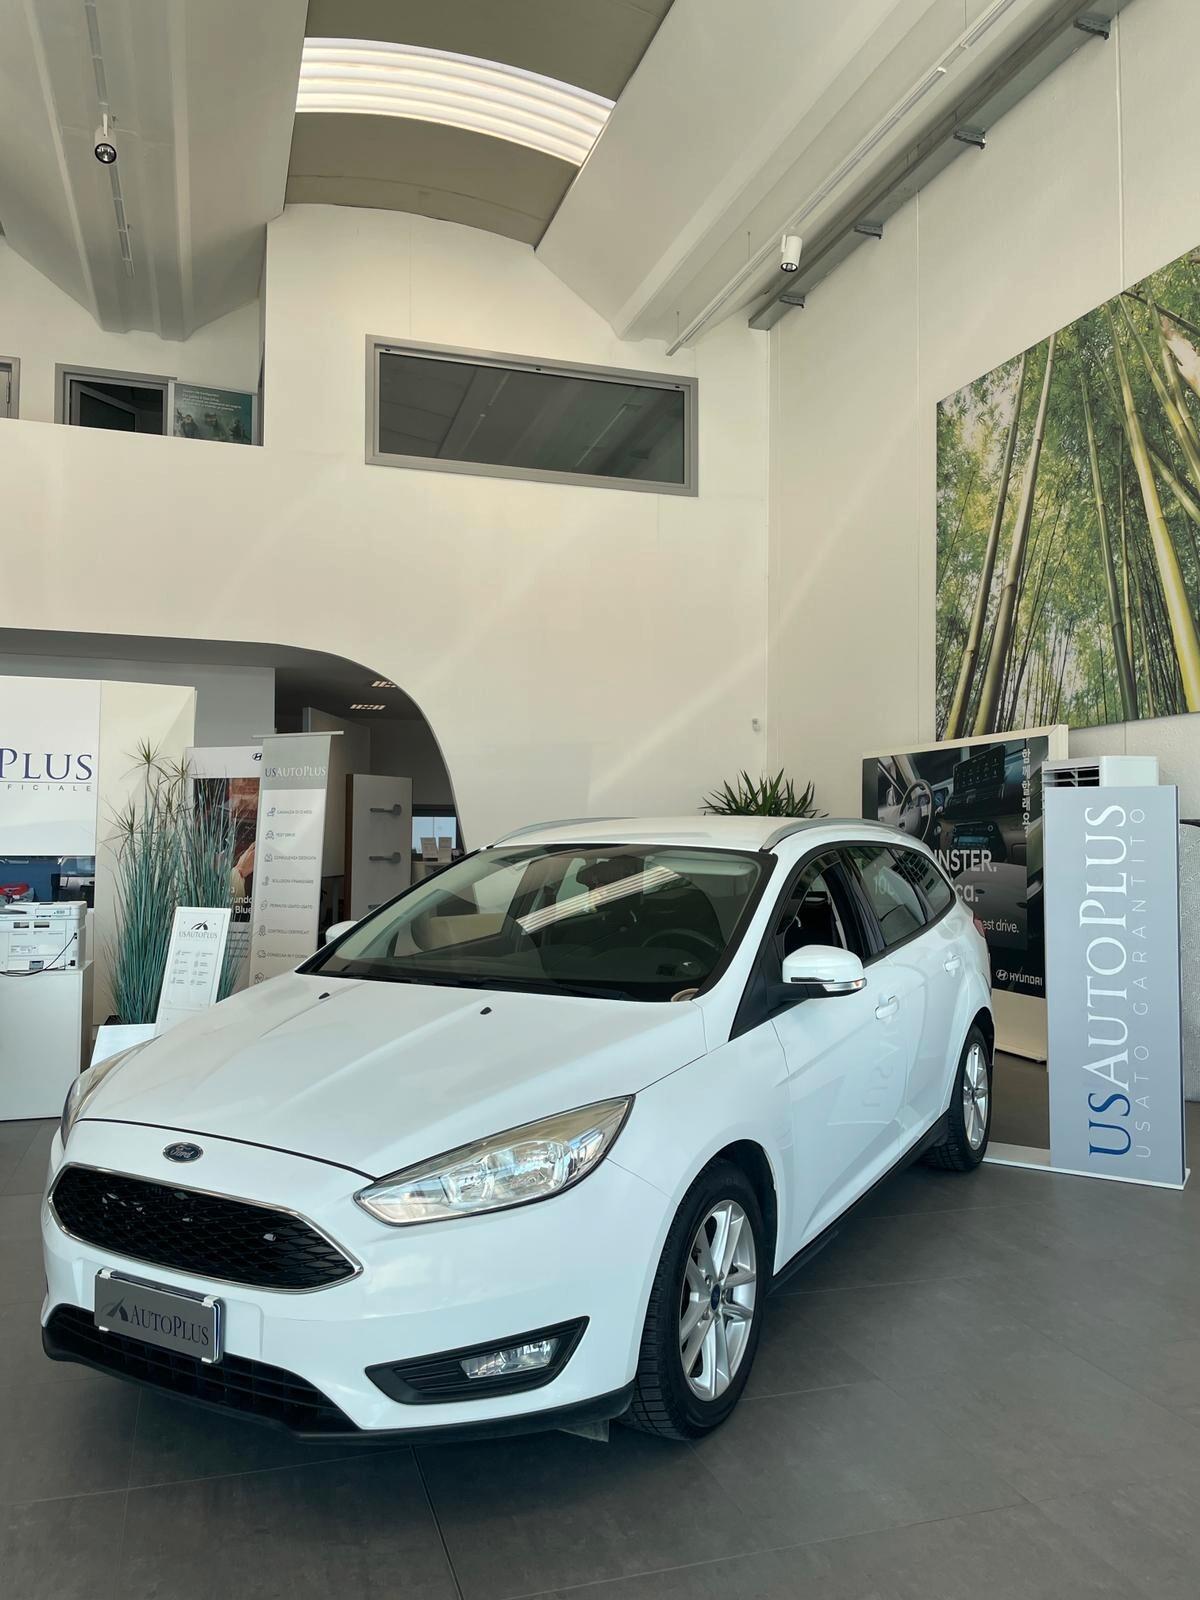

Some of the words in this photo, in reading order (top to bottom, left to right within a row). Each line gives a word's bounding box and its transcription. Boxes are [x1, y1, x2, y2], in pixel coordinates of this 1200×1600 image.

[0, 748, 92, 780] PLUS
[996, 919, 1020, 934] drive.
[1130, 808, 1149, 1015] GARANTITO
[1009, 972, 1043, 987] HYUNDAI
[1079, 805, 1132, 1158] USAUTOPLUS
[1133, 1045, 1151, 1158] USATO
[170, 1144, 195, 1159] Ford
[130, 1304, 210, 1346] AUTOPLUS
